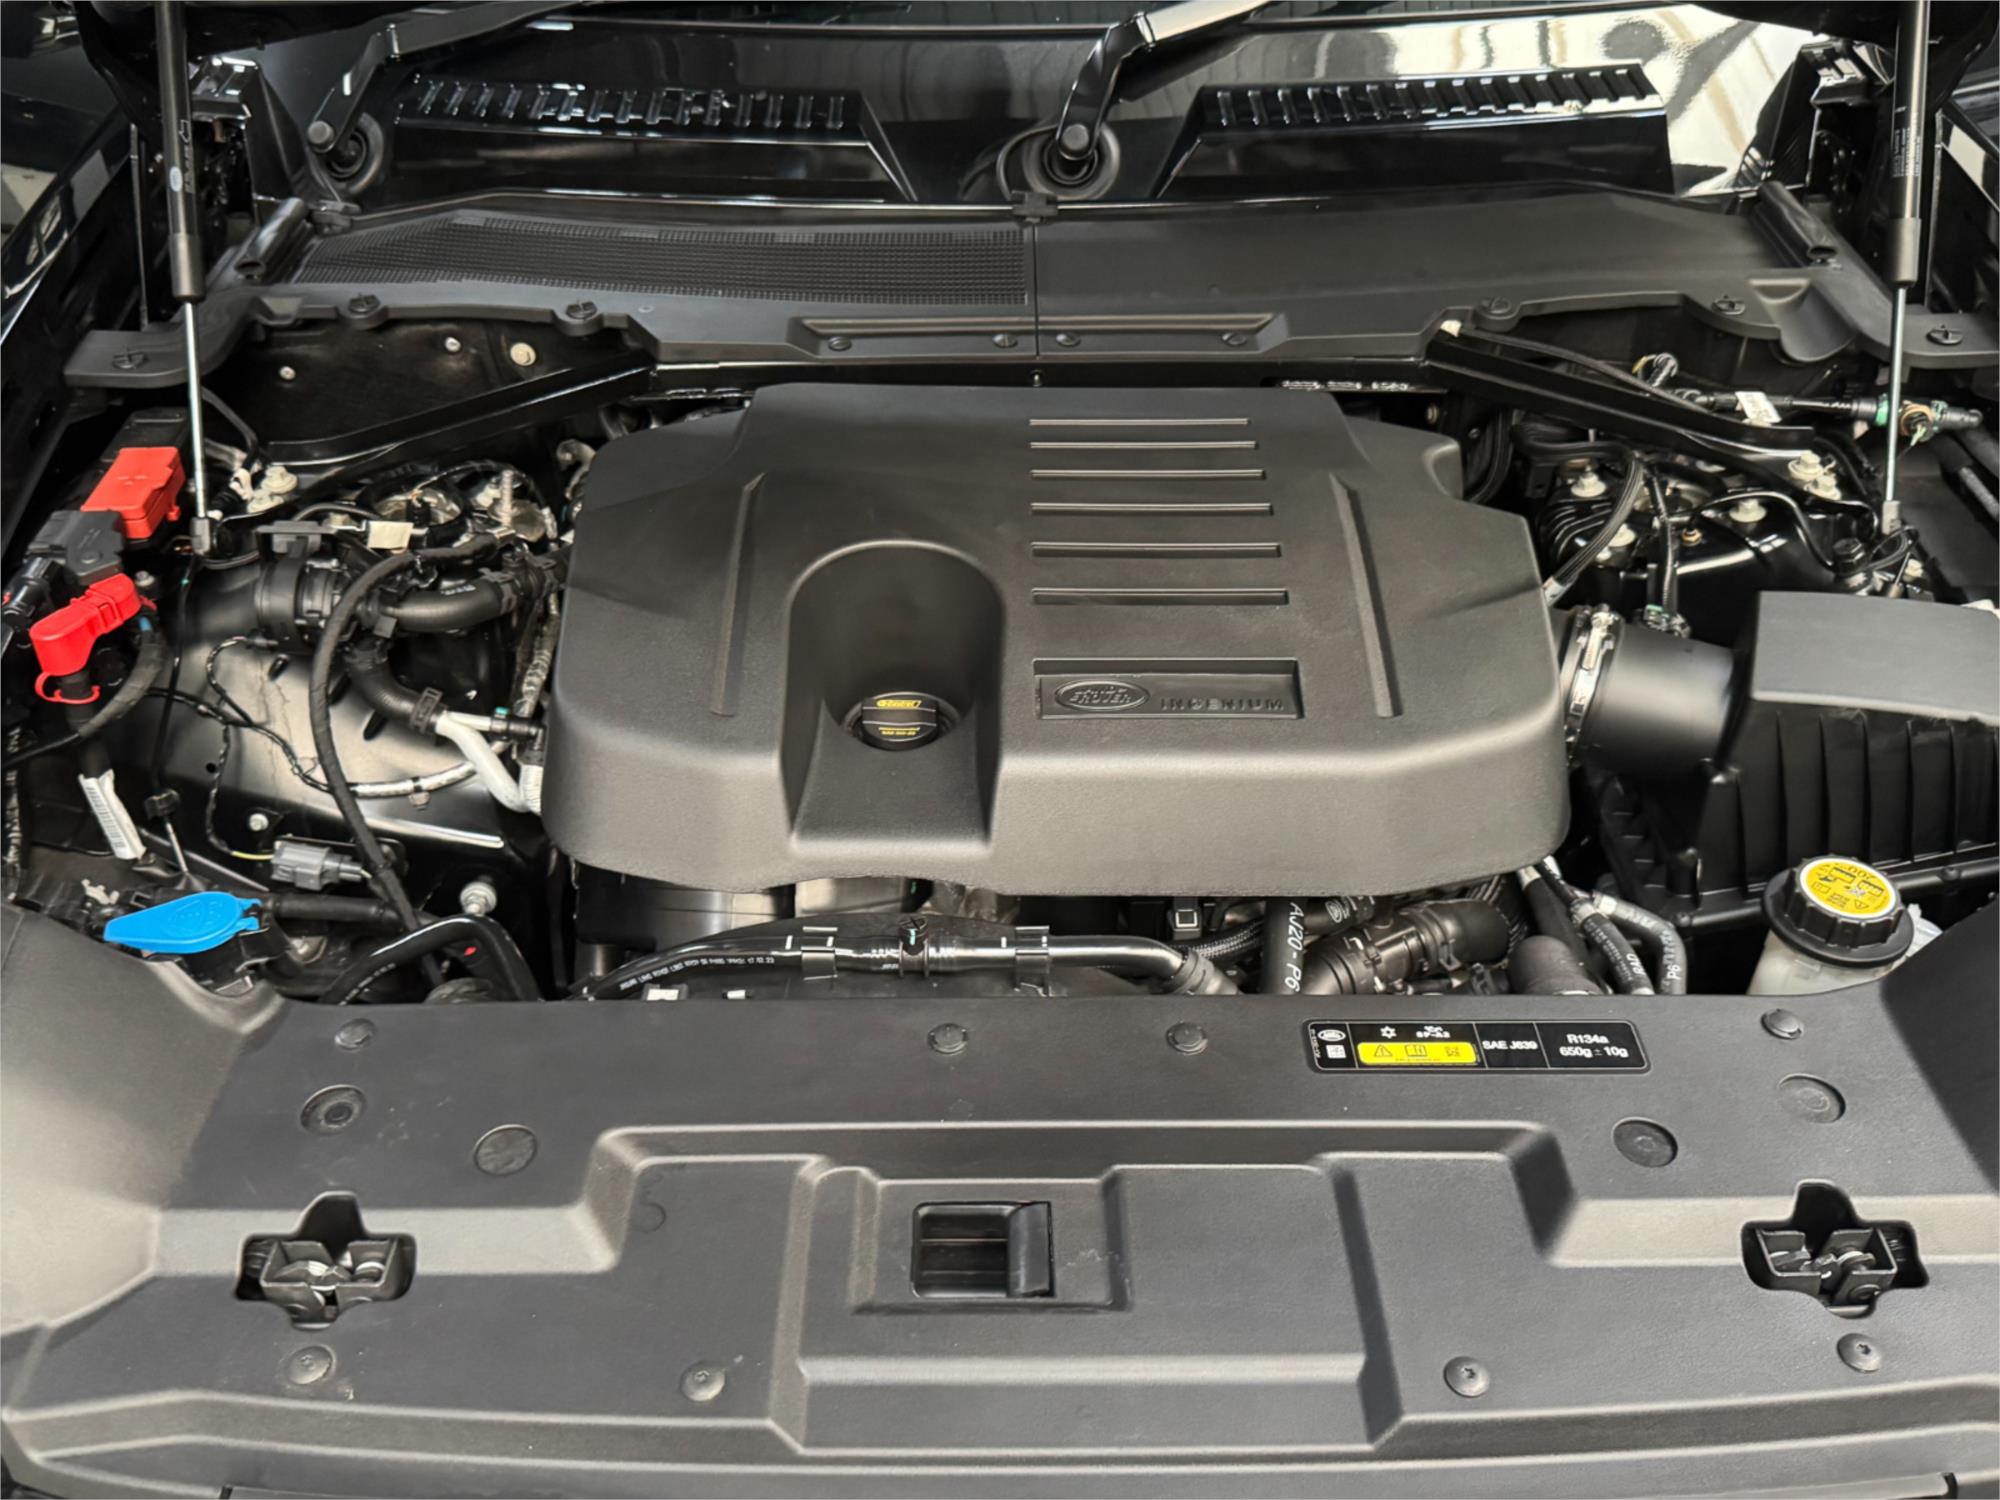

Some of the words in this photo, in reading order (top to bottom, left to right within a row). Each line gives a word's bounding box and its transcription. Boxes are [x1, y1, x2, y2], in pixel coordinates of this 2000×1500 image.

[1566, 1034, 1610, 1044] R134a
[1482, 1040, 1508, 1050] SAE
[1509, 1040, 1538, 1050] J639
[1559, 1046, 1593, 1058] 650g
[1603, 1046, 1629, 1058] 10g
